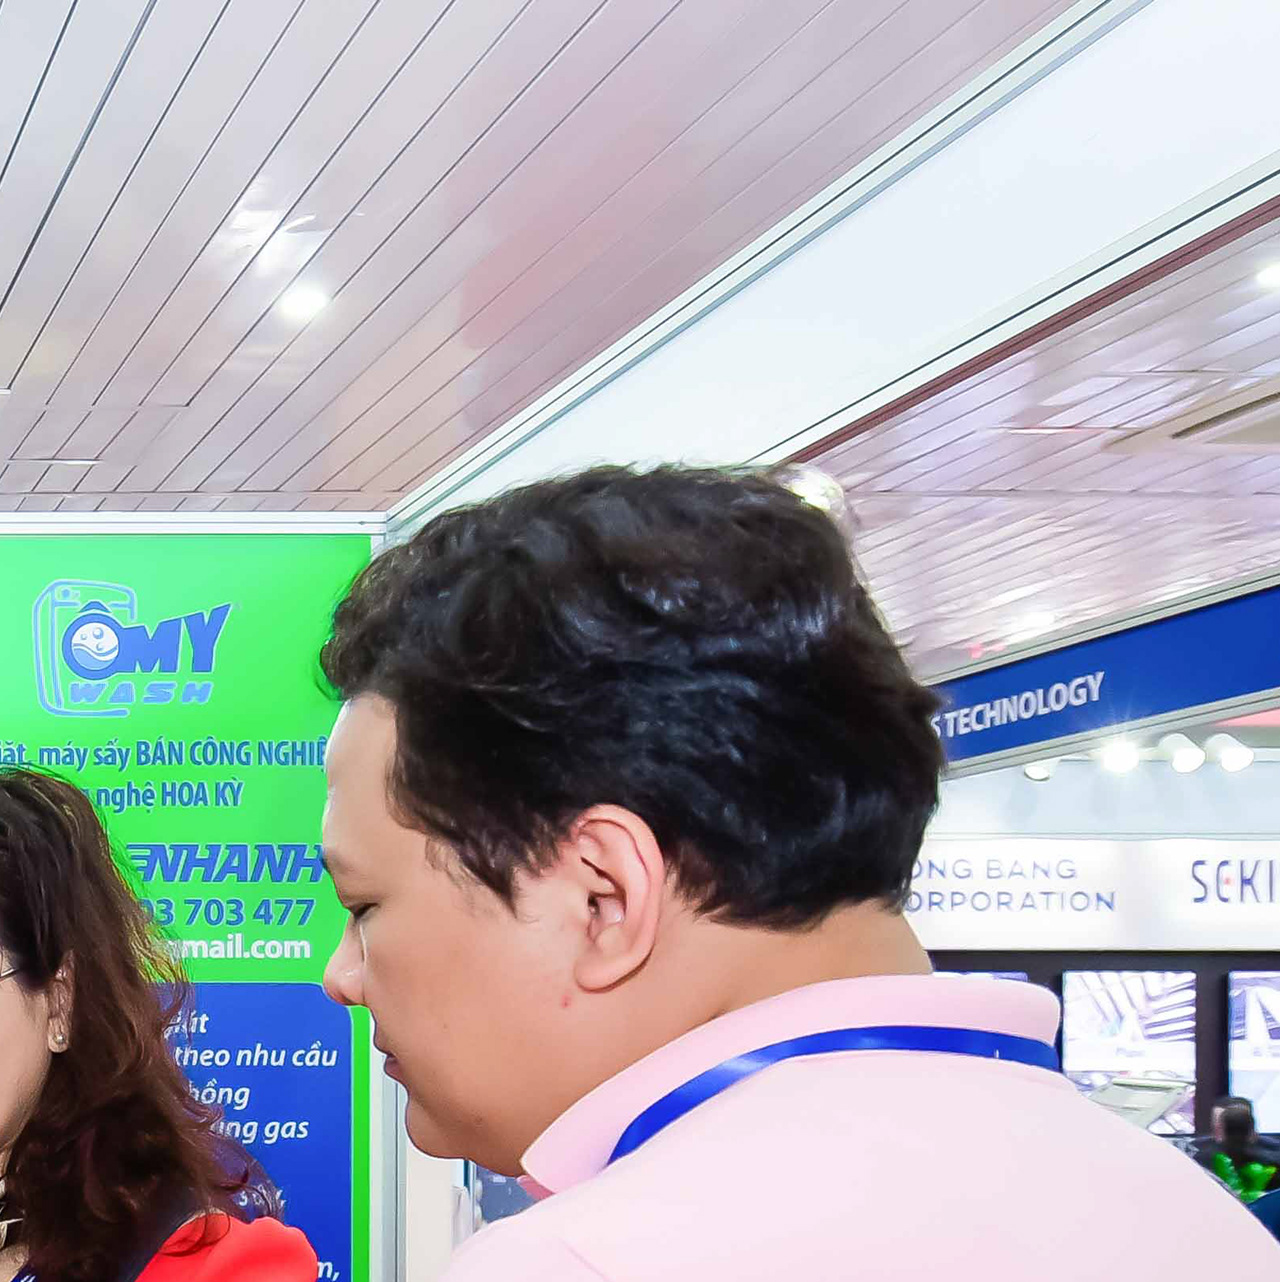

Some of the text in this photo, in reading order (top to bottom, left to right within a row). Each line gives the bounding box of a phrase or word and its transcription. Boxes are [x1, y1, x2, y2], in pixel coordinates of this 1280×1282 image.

[68, 681, 214, 705] WASH
[944, 670, 1106, 739] TECHNOLOGY
[38, 742, 88, 772] máy
[92, 738, 131, 772] sấy
[136, 736, 184, 767] BÁN
[190, 735, 252, 768] CÔNG
[257, 734, 327, 772] NGHIỆ
[97, 781, 156, 814] nghệ
[161, 784, 209, 808] HOA
[130, 842, 324, 885] NHANH
[986, 858, 1078, 881] BANG
[184, 898, 245, 927] 703
[252, 898, 316, 927] 477
[906, 890, 1117, 914] ORPORATION
[175, 1040, 339, 1068] theo nhu cầu
[263, 1119, 310, 1145] gas
